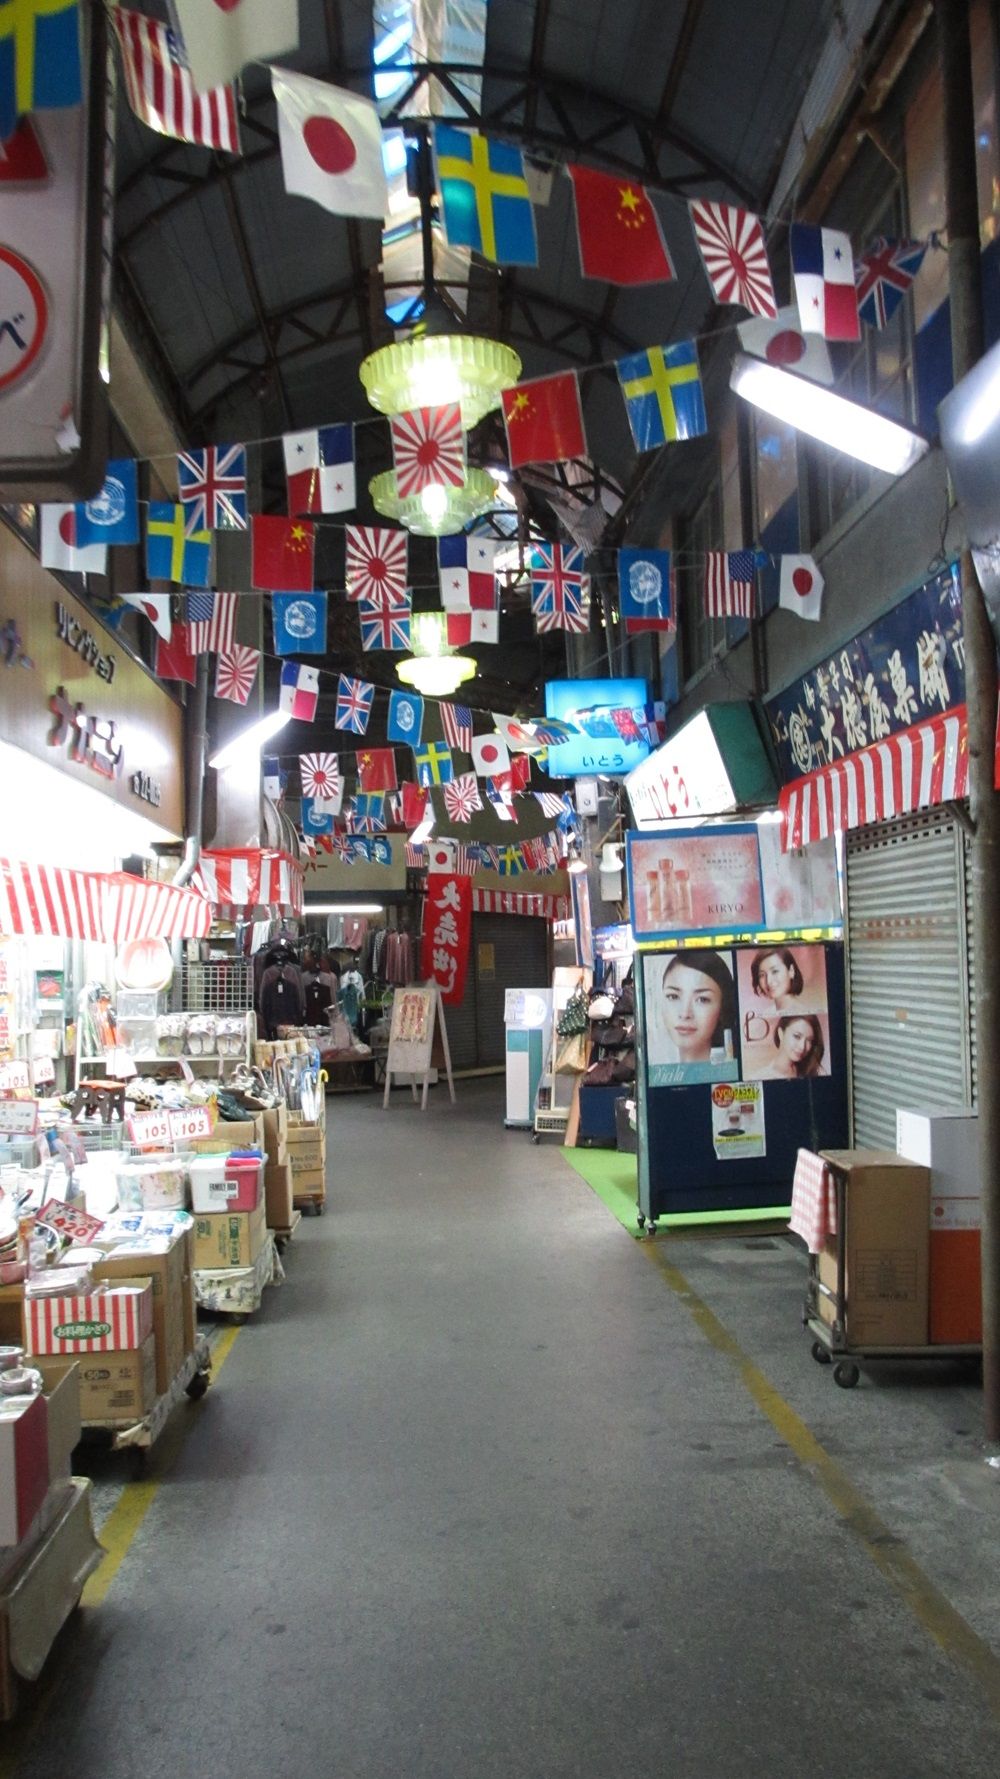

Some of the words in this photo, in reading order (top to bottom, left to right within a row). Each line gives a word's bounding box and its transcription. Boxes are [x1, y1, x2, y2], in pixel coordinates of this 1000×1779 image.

[582, 754, 624, 767] いとう
[648, 766, 690, 820] いとう
[707, 903, 744, 914] KIRYO
[427, 880, 461, 993] 大売出し
